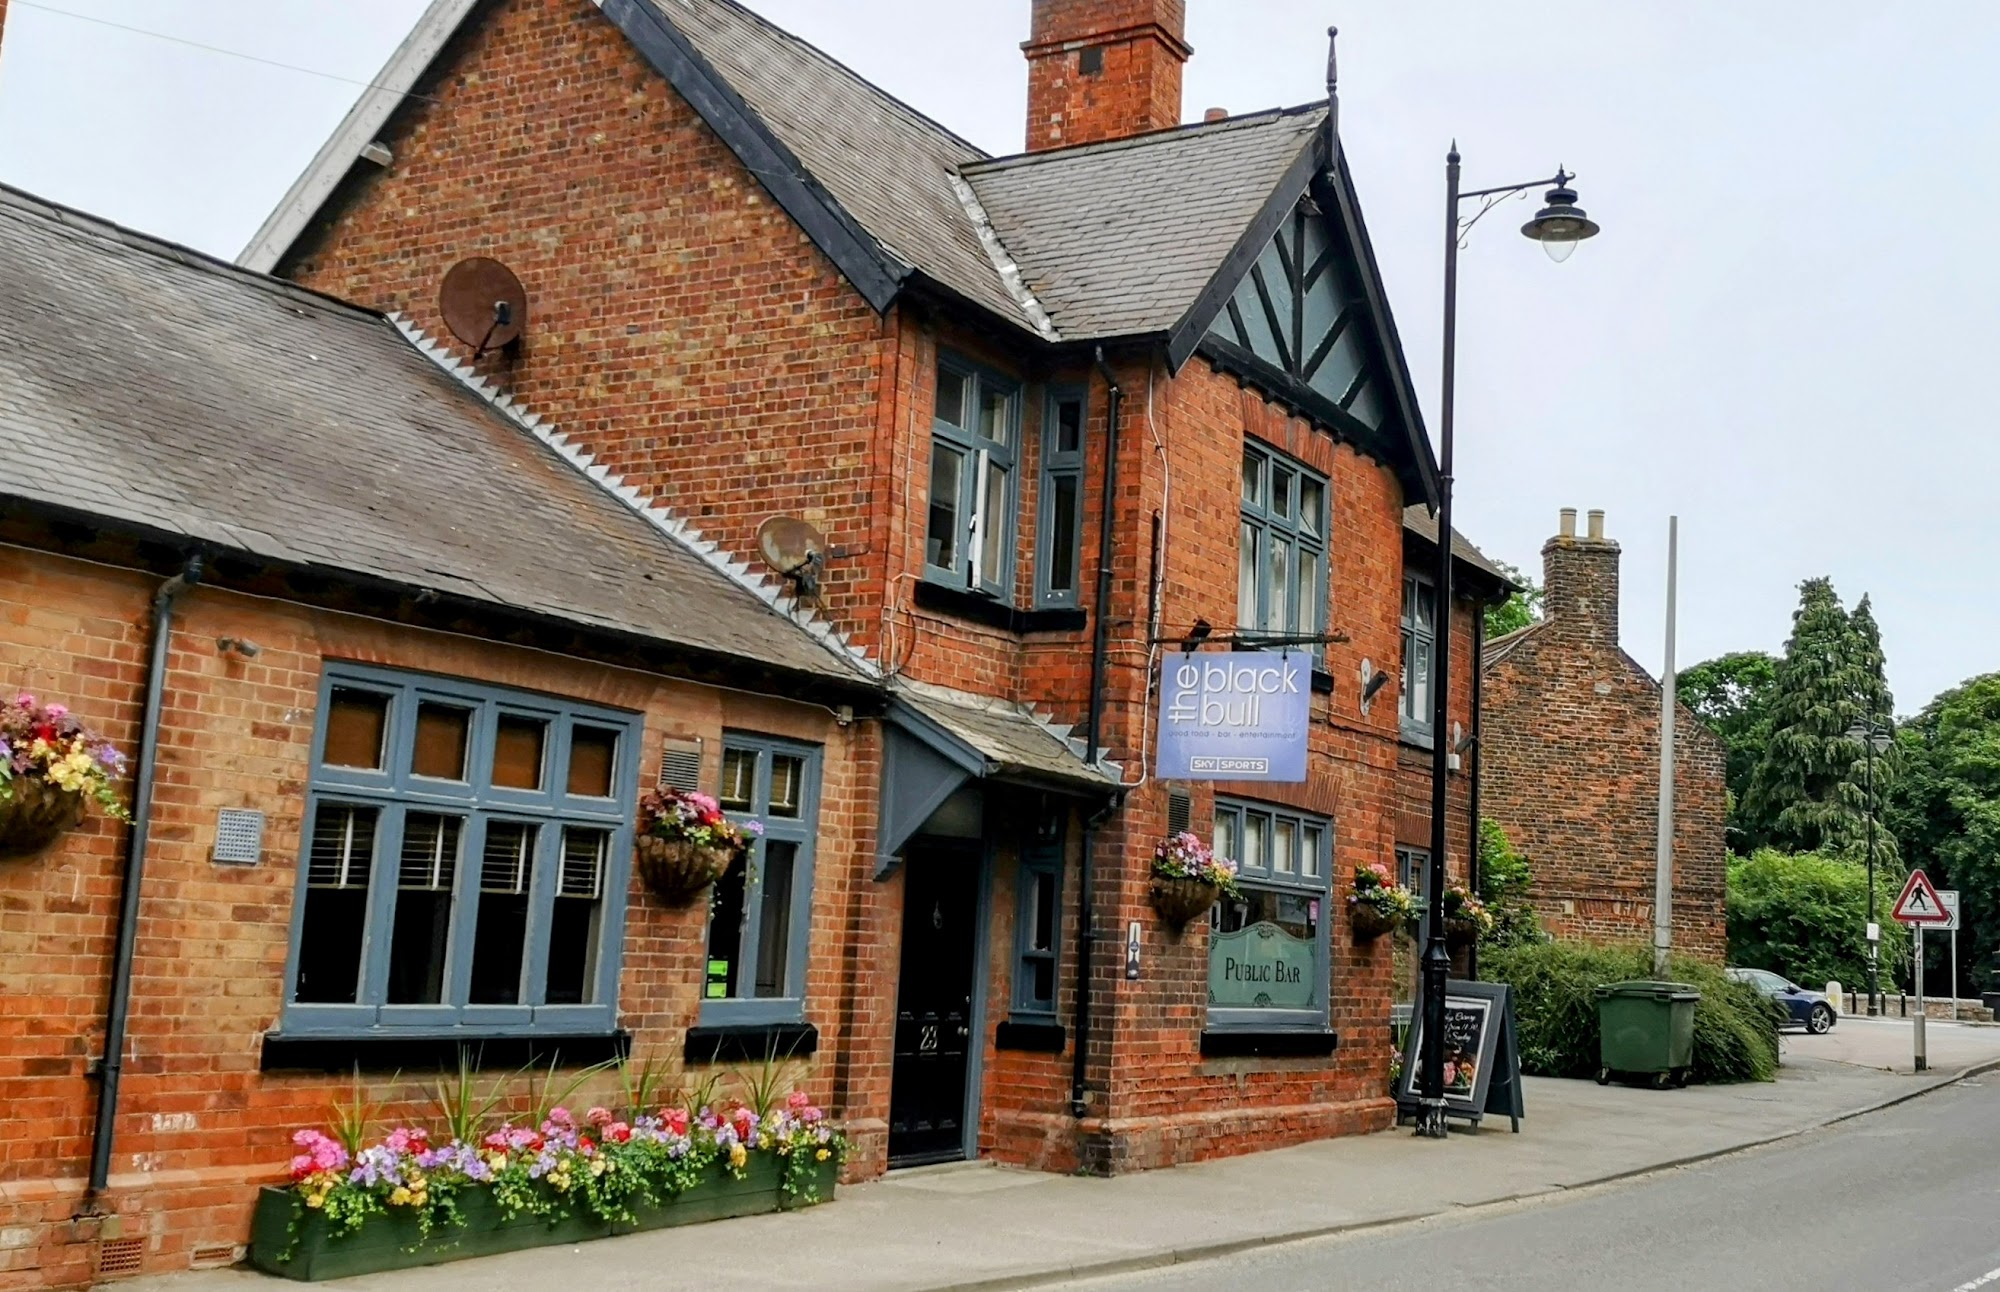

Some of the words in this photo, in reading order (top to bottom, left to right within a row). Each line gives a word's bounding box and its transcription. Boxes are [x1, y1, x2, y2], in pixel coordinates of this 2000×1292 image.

[1204, 661, 1299, 694] black
[1168, 664, 1199, 724] the
[1203, 694, 1260, 727] bull
[1217, 730, 1231, 738] bar
[1194, 760, 1216, 769] SKY
[1221, 761, 1265, 770] SPORTS
[920, 1025, 938, 1050] 23
